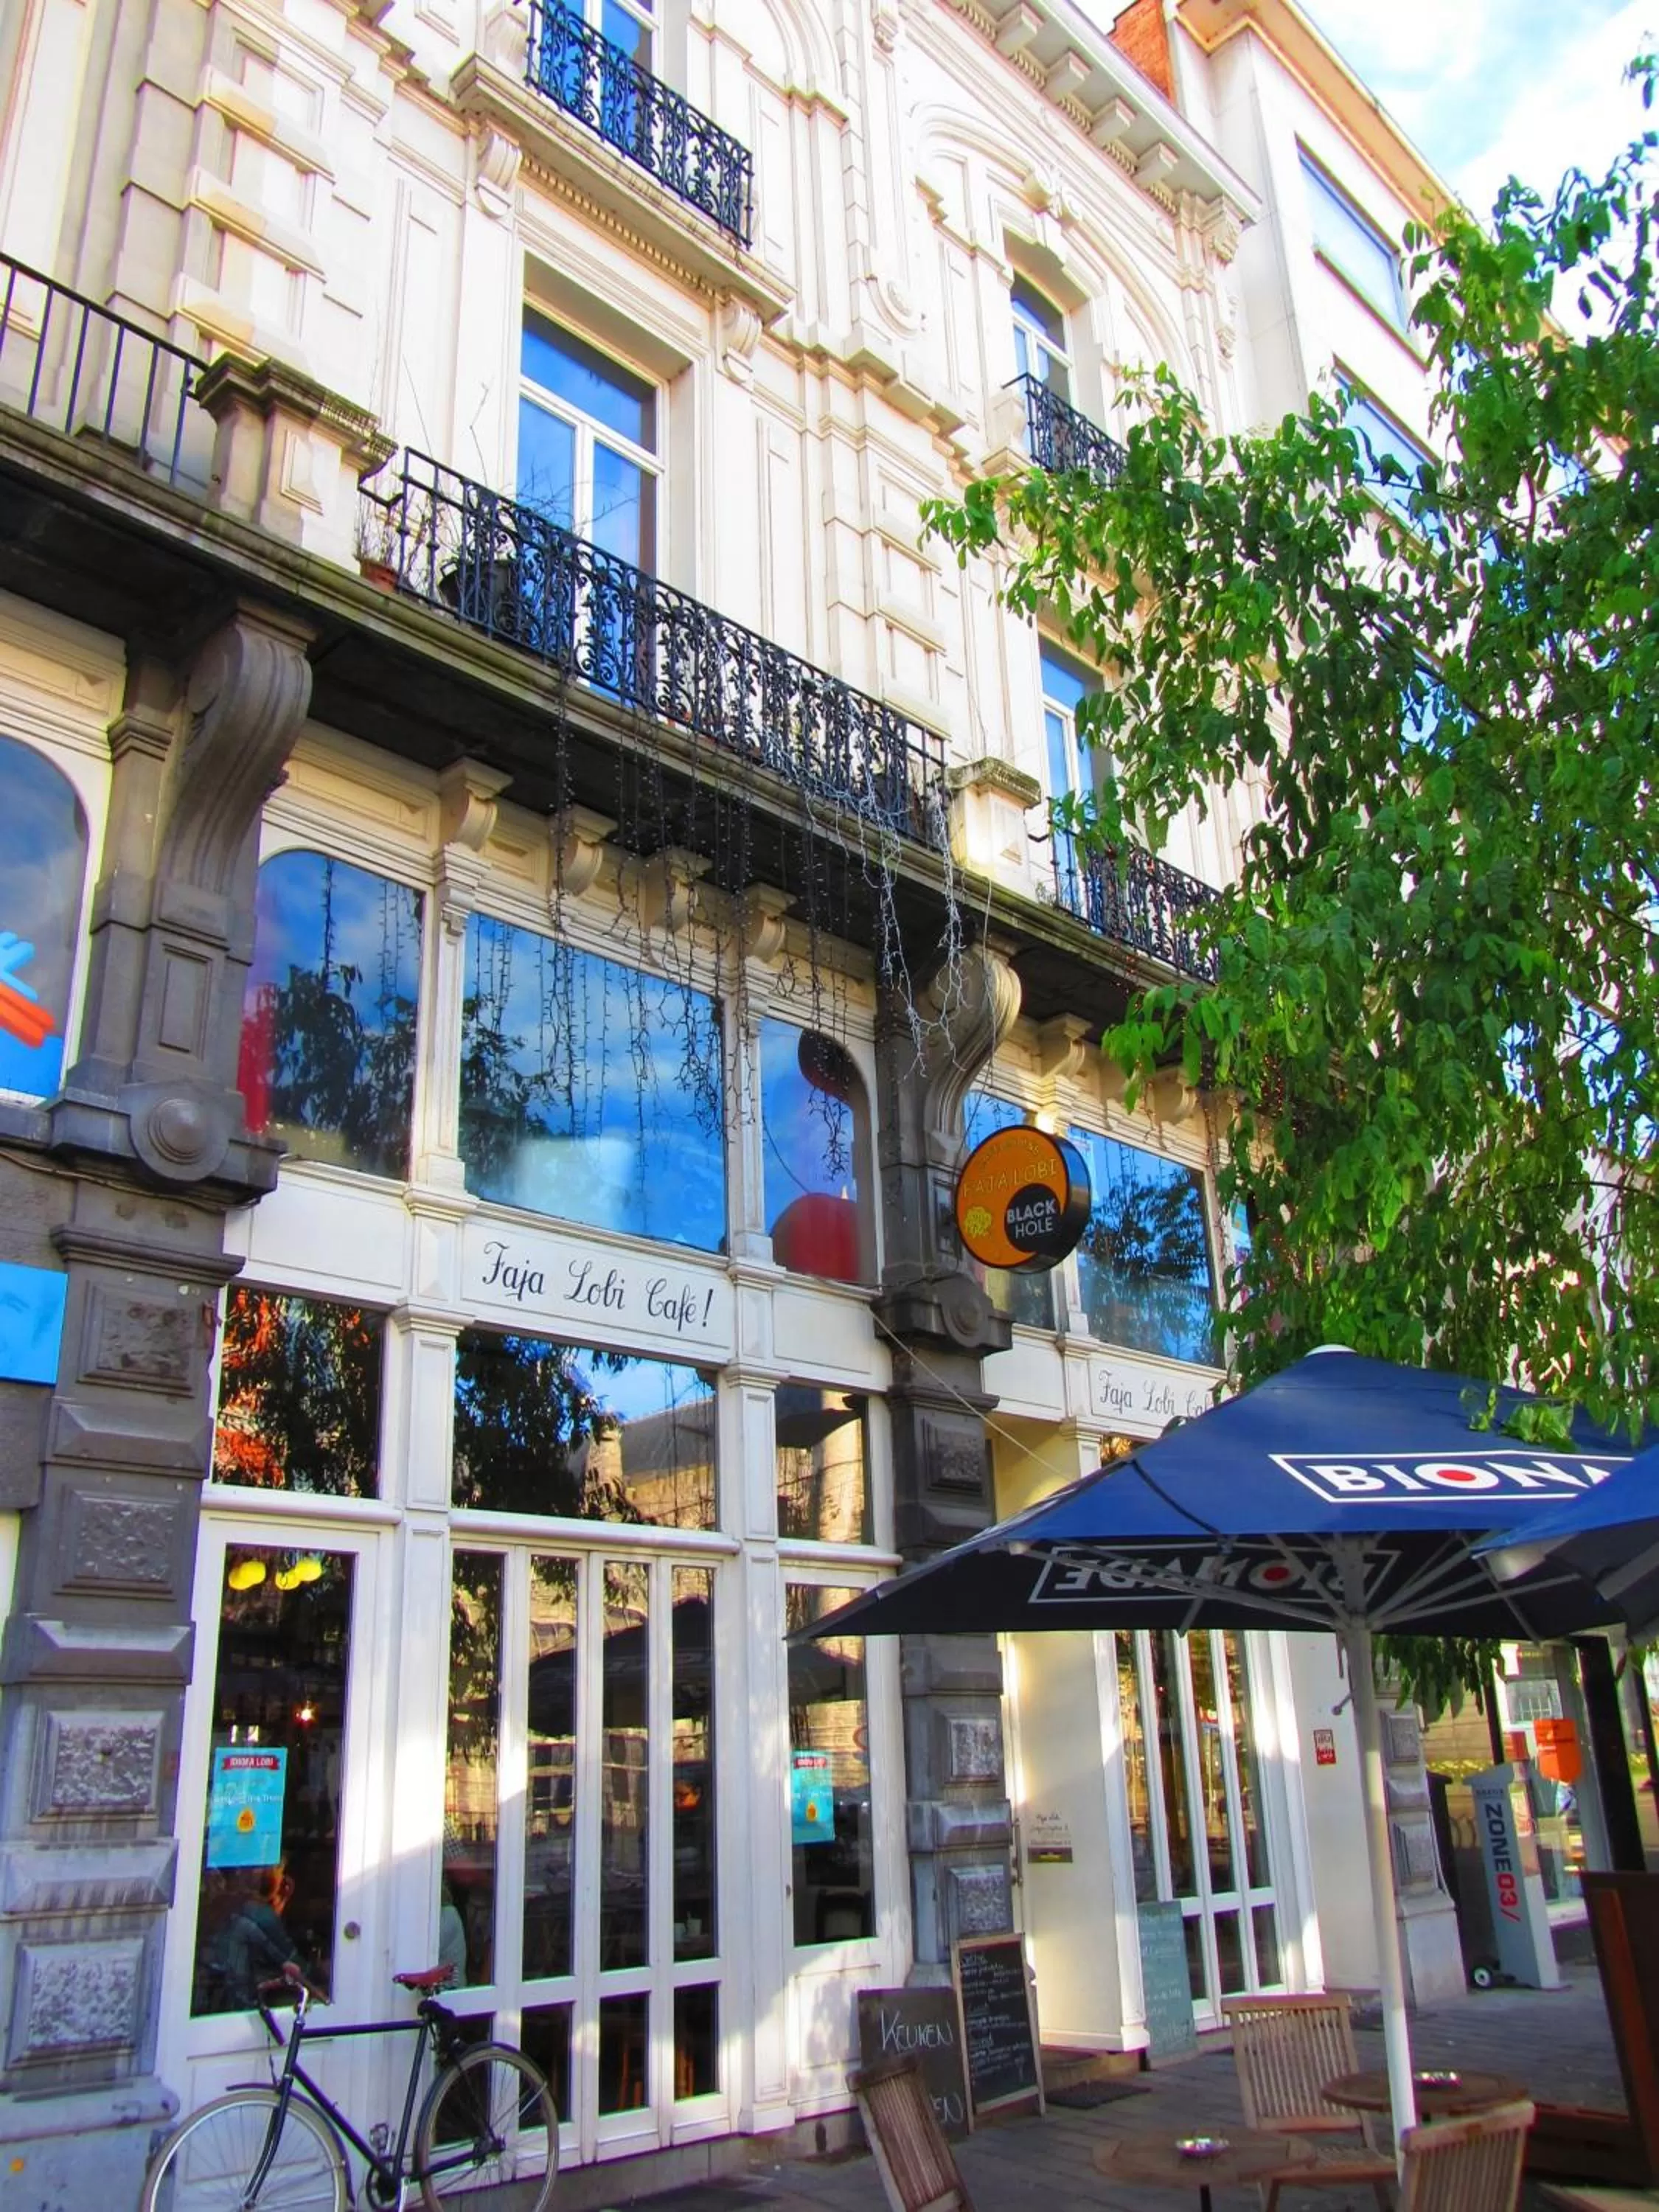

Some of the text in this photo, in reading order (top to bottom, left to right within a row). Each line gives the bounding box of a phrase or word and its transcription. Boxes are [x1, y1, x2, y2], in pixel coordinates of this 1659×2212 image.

[1006, 1198, 1057, 1225] BLACK
[1015, 1217, 1054, 1239] HOLE
[481, 1240, 544, 1302] Faja
[563, 1257, 626, 1311] Lobi
[1098, 1369, 1133, 1415] Faja
[1143, 1379, 1175, 1416] Lobi
